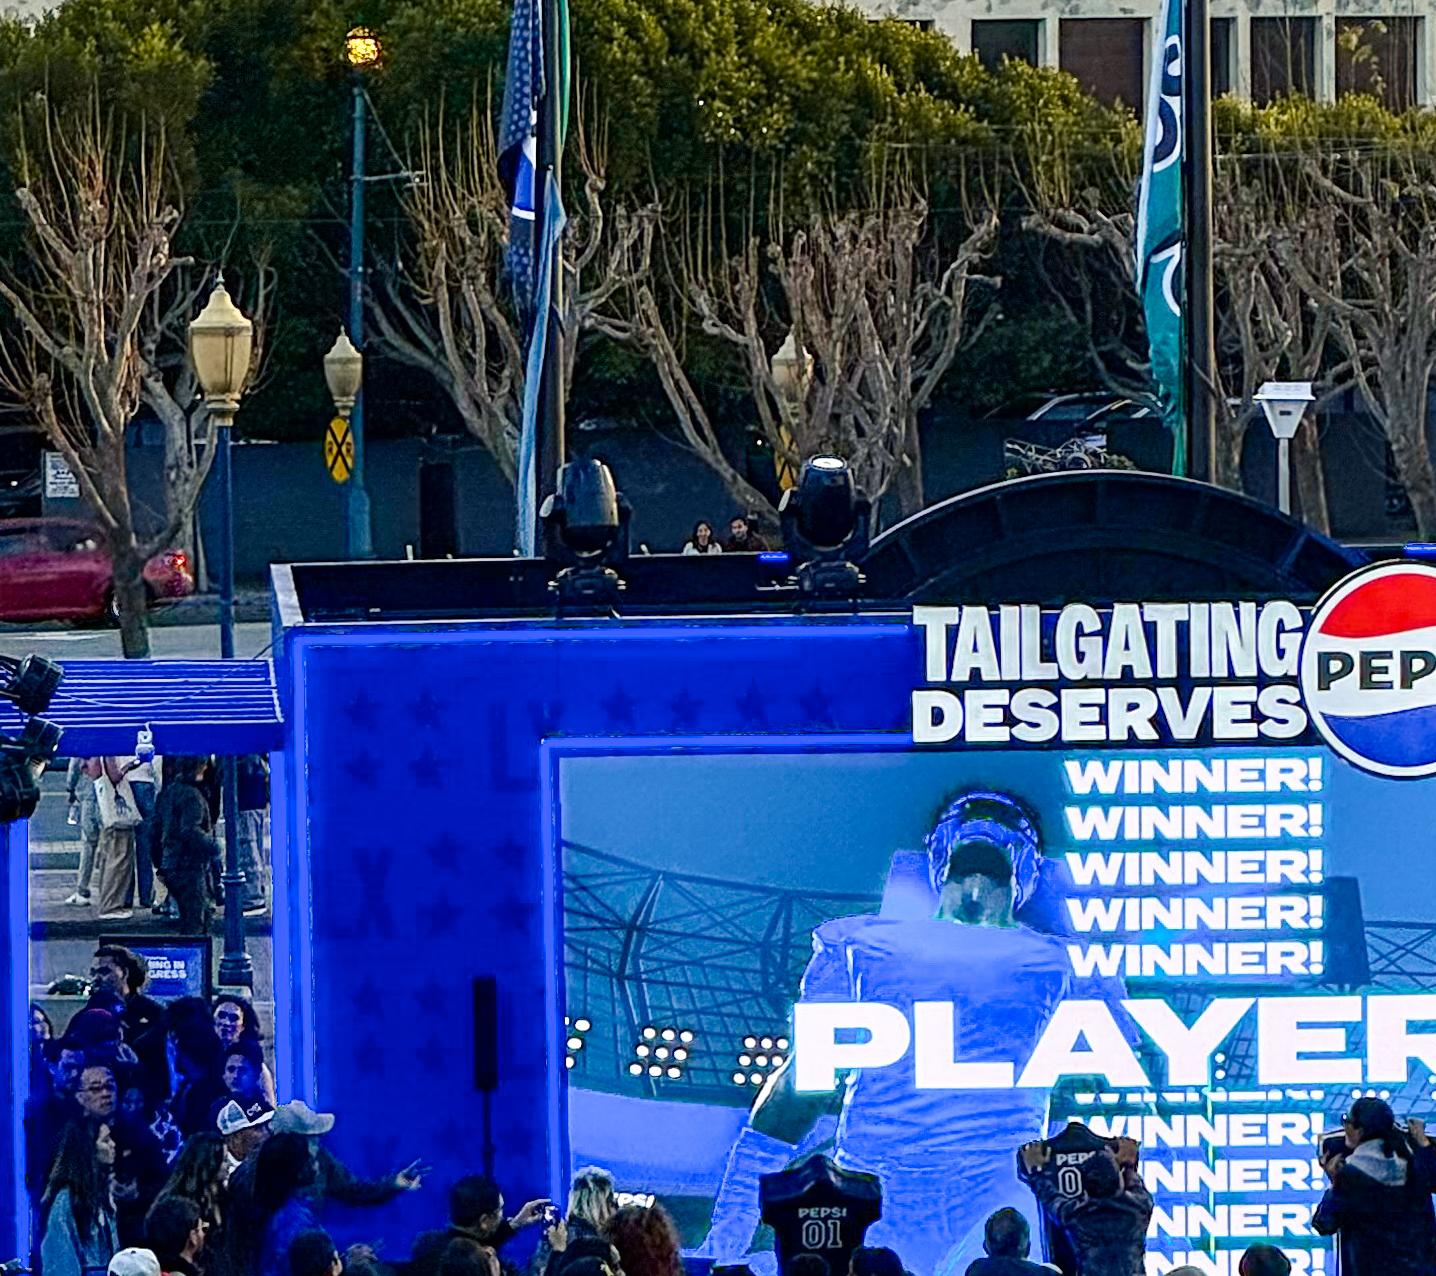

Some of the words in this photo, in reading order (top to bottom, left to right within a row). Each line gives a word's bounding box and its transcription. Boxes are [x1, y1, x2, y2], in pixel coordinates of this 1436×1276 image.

[912, 601, 1304, 683] TAILGATING
[912, 685, 1308, 743] DESERVES
[1065, 757, 1324, 795] WINNER!
[1065, 804, 1324, 840] WINNER!
[1065, 850, 1324, 886] WINNER!
[1065, 895, 1324, 932] WINNER!
[1065, 941, 1324, 977] WINNER!
[798, 1207, 847, 1219] PEPSI
[802, 1219, 843, 1250] 01
